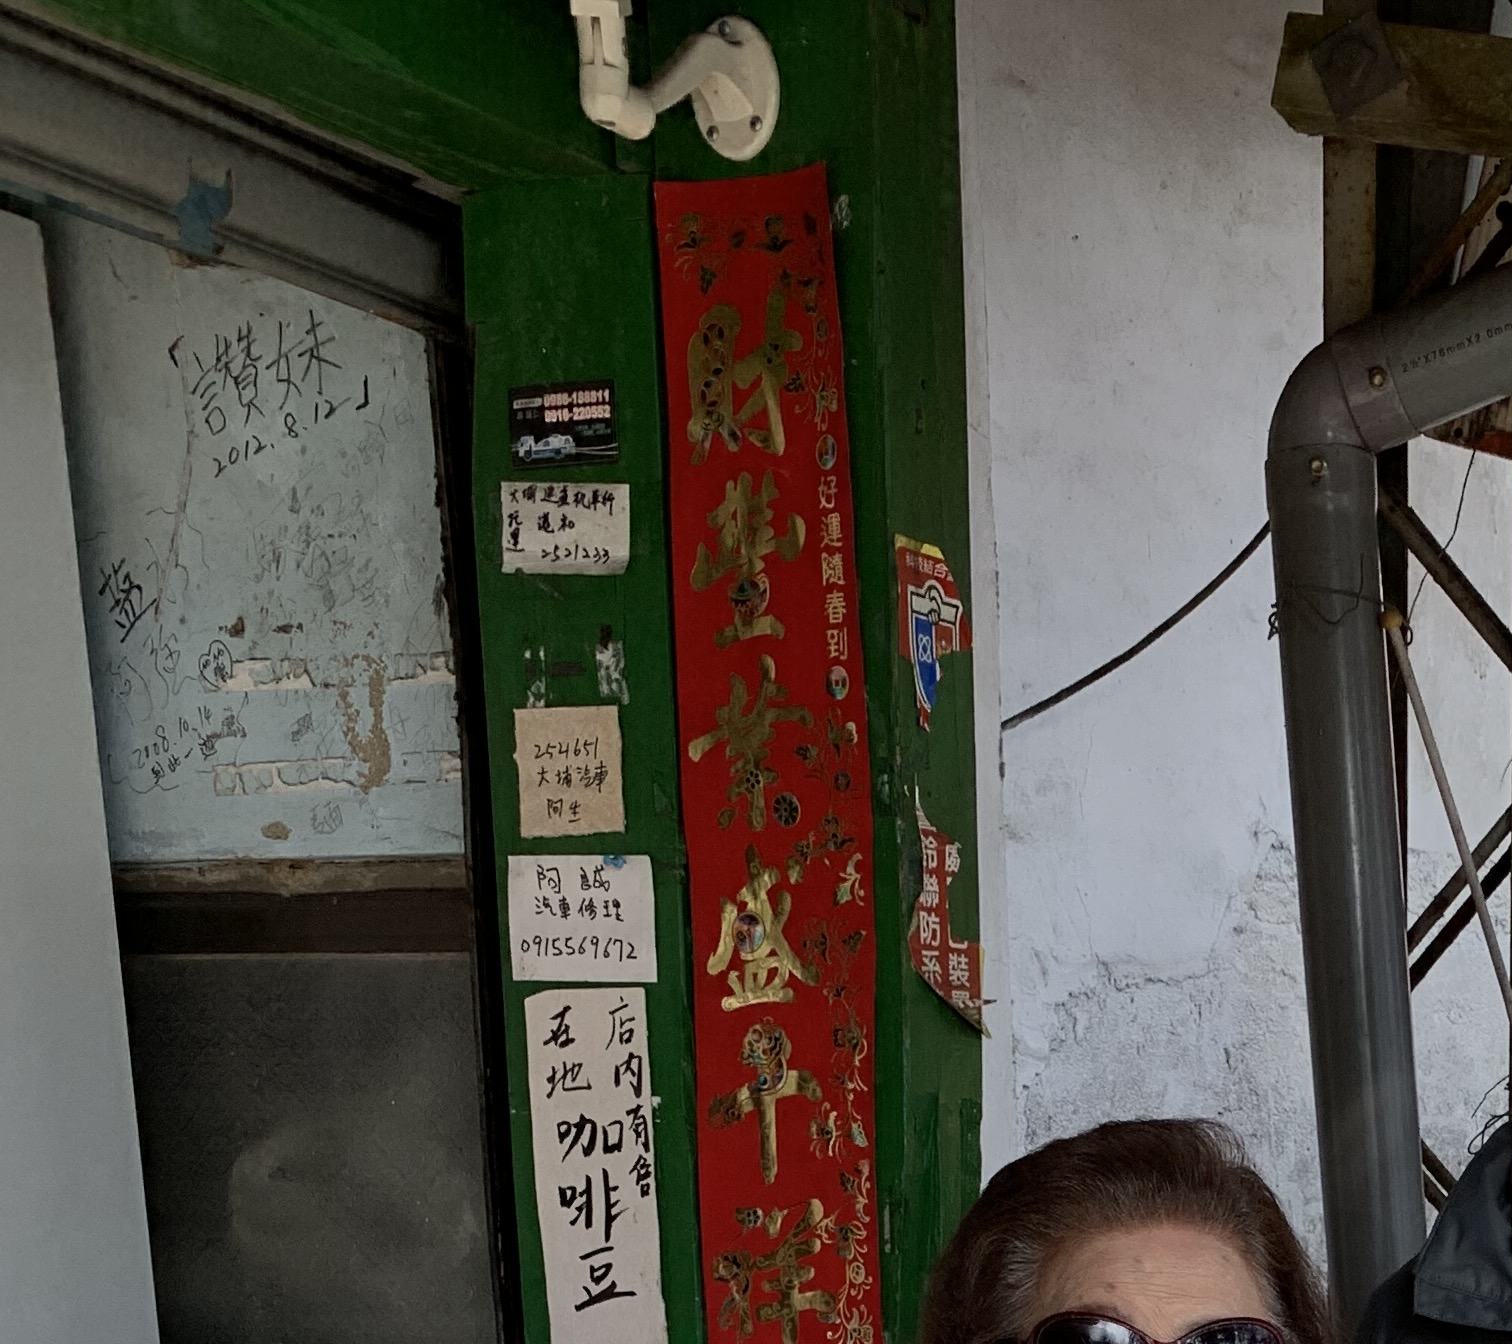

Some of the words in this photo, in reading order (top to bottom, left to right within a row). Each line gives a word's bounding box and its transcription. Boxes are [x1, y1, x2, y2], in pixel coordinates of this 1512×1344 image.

[817, 474, 849, 661] 好運隨春到
[537, 764, 609, 794] 大埔汽車
[546, 798, 582, 823] 阿生
[535, 897, 625, 923] 汽車修理
[520, 935, 638, 963] 0915569672
[542, 1004, 638, 1312] 在地咖啡豆
